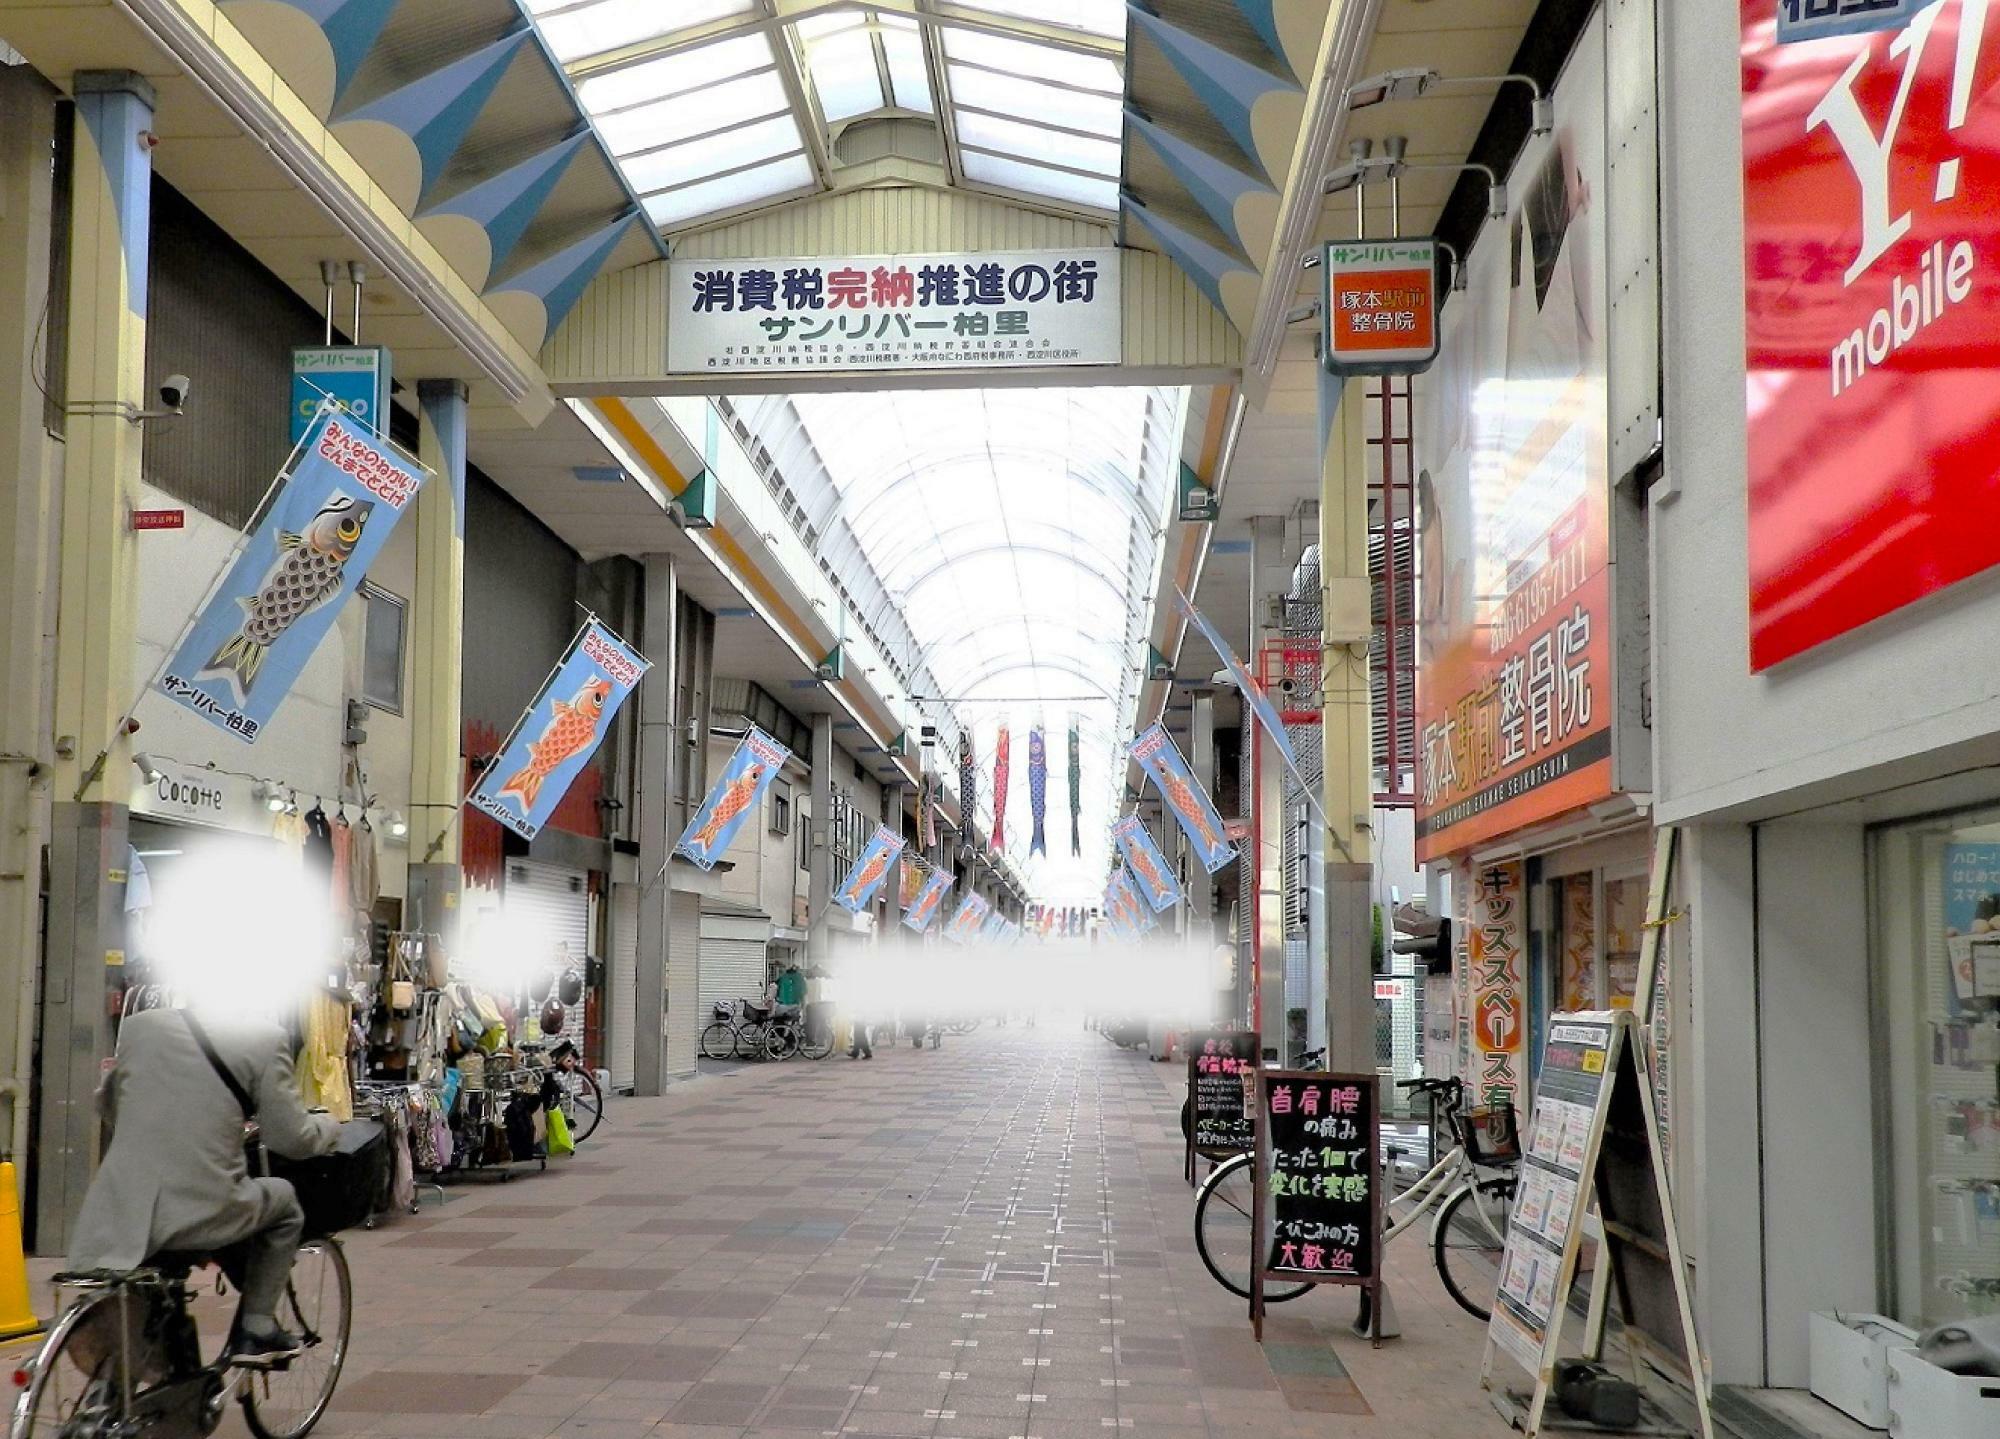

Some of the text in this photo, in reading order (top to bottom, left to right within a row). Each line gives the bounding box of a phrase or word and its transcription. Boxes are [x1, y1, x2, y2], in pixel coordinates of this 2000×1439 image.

[692, 260, 1098, 313] 消費税完納推進の街
[1340, 288, 1425, 310] 塚本駅前
[759, 311, 1030, 342] サンリバー柏里
[1352, 311, 1416, 332] 整骨院
[1832, 240, 1973, 398] mobile
[164, 675, 258, 739] サンリバー柏里
[1422, 605, 1592, 805] 塚本駅前整骨院
[476, 793, 536, 837] サンリバー柏里
[1482, 867, 1514, 1144] キッズスペース有り
[1271, 1085, 1361, 1115] 首肩腰
[1304, 1115, 1358, 1140] の痛み
[1268, 1169, 1369, 1202] 変化を実感
[1272, 1219, 1360, 1246] とびこみの方
[1279, 1240, 1355, 1270] 大歓迎
